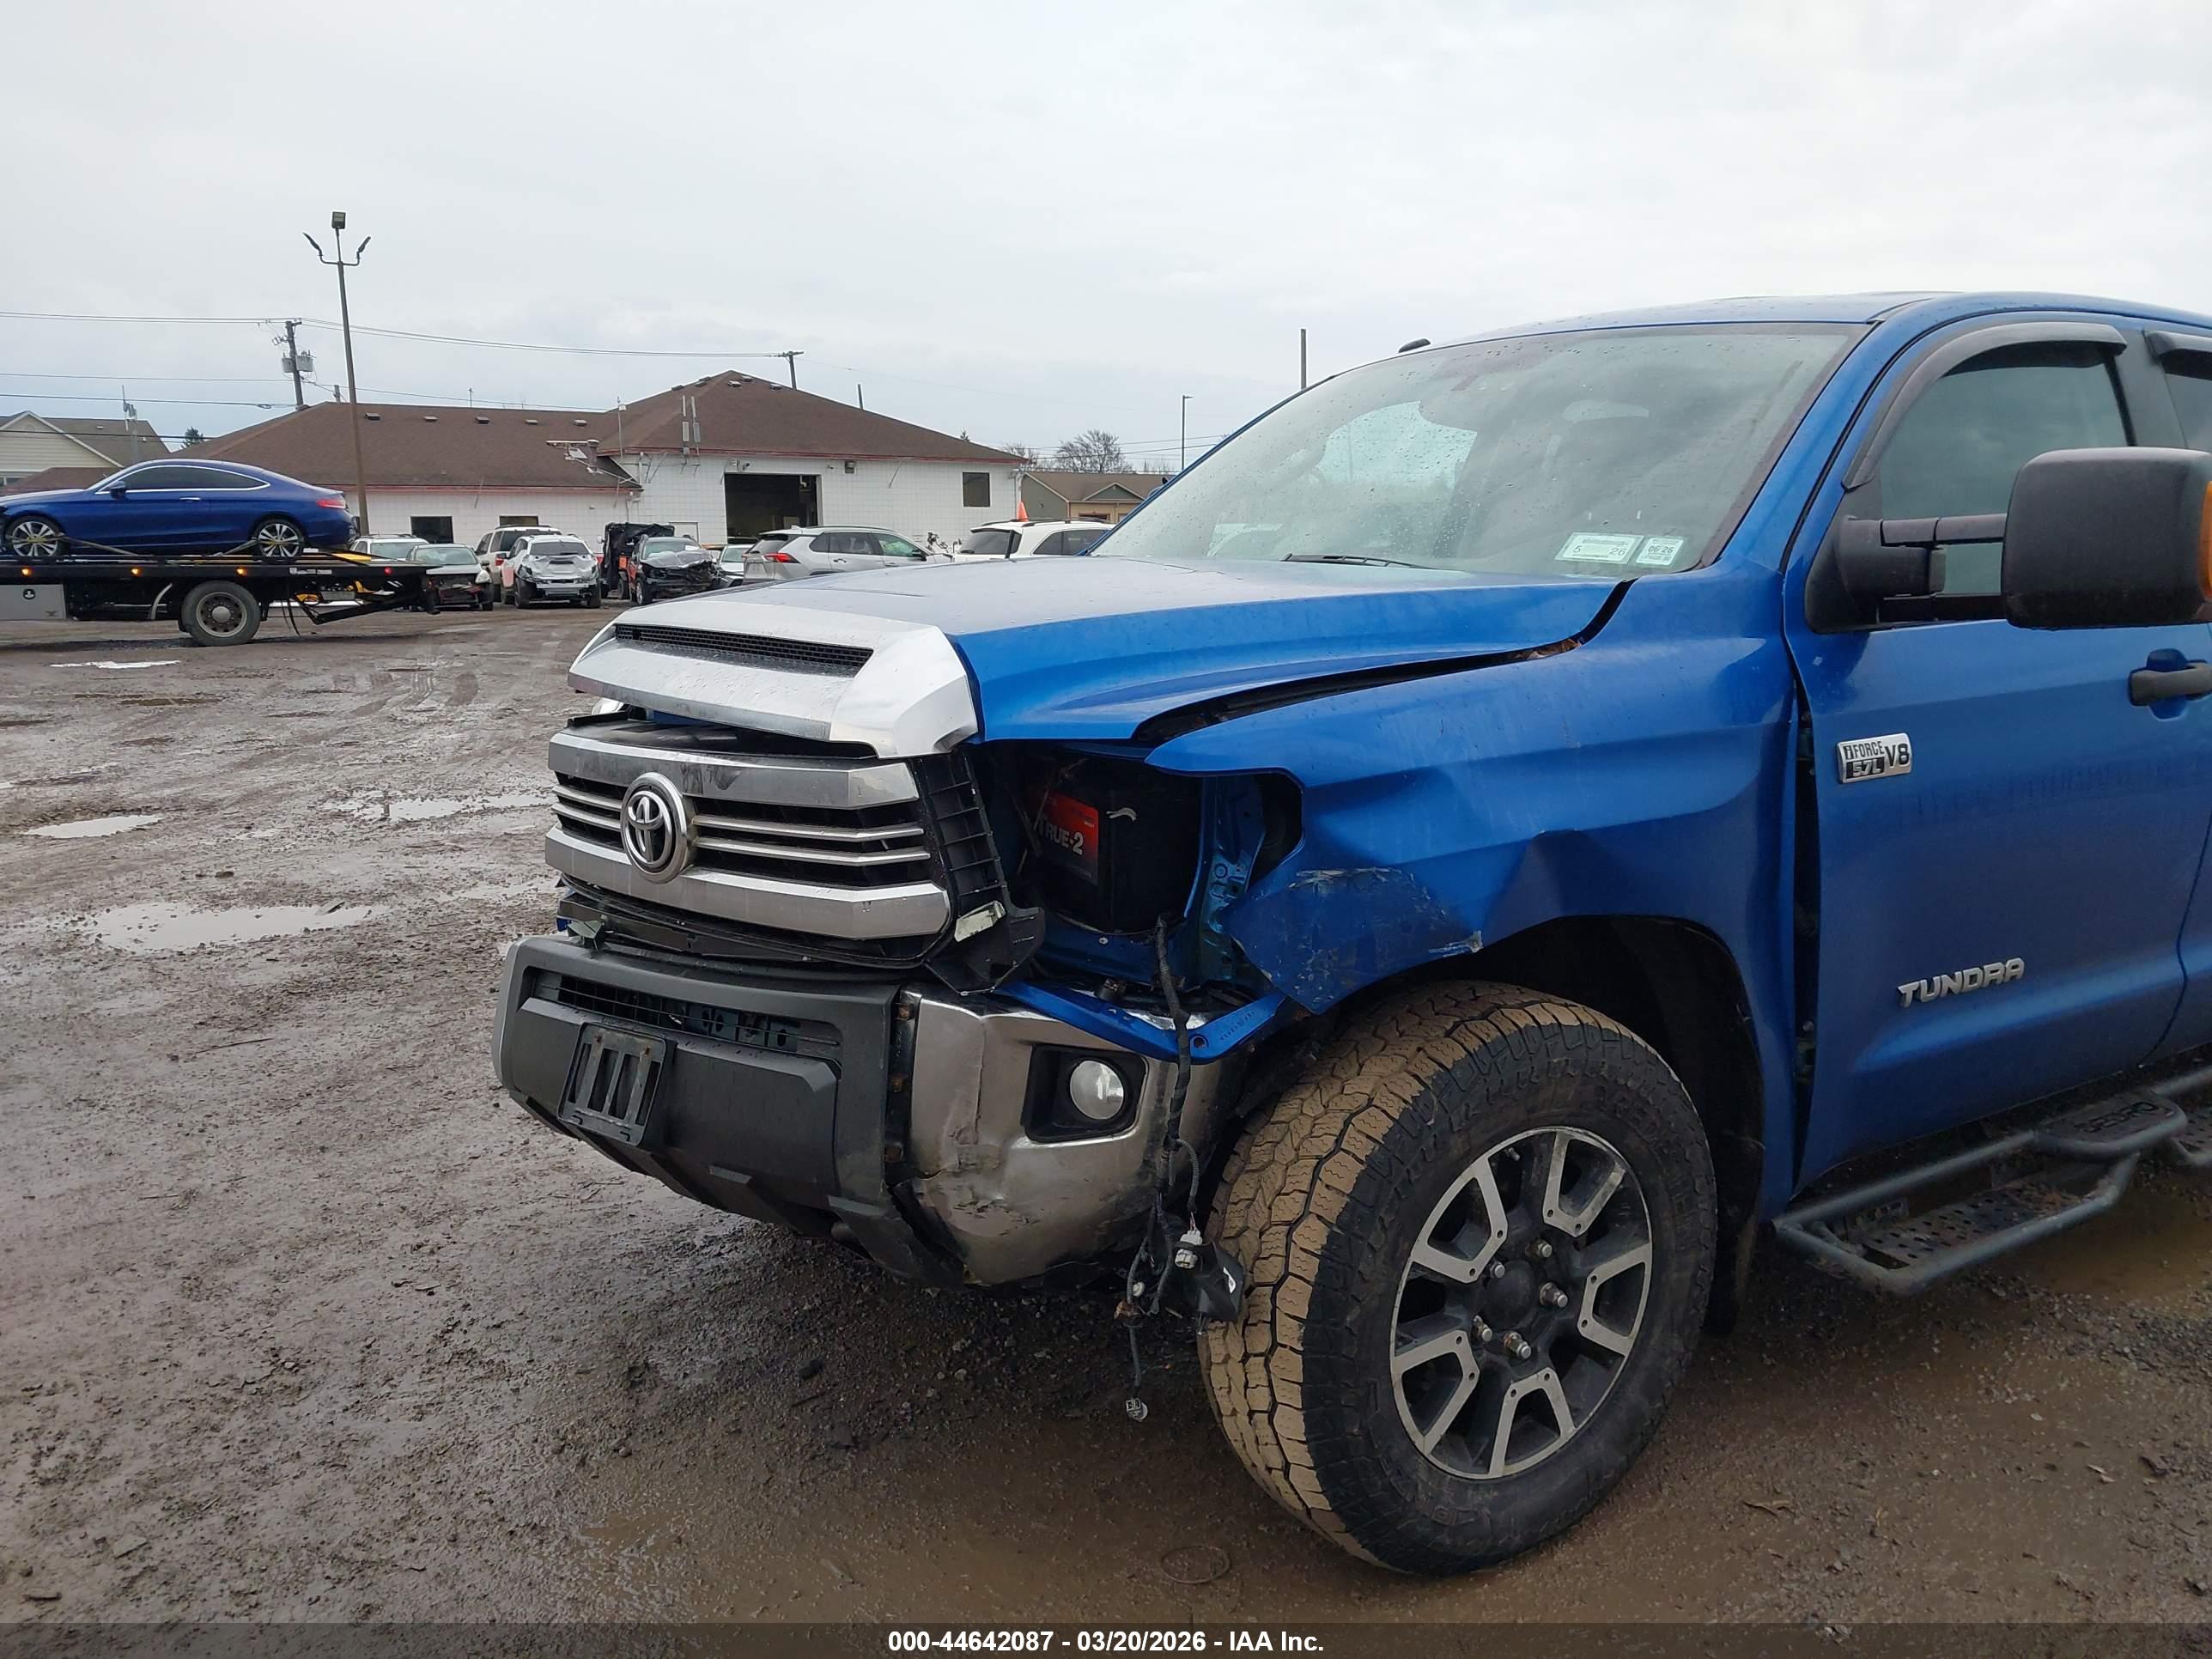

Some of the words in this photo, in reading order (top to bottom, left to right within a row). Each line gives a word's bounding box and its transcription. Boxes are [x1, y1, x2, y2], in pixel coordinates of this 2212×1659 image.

[1572, 544, 1582, 554] 5
[1609, 546, 1627, 556] 26
[1885, 743, 1910, 765] V8
[1898, 957, 2025, 1008] TUNDRA
